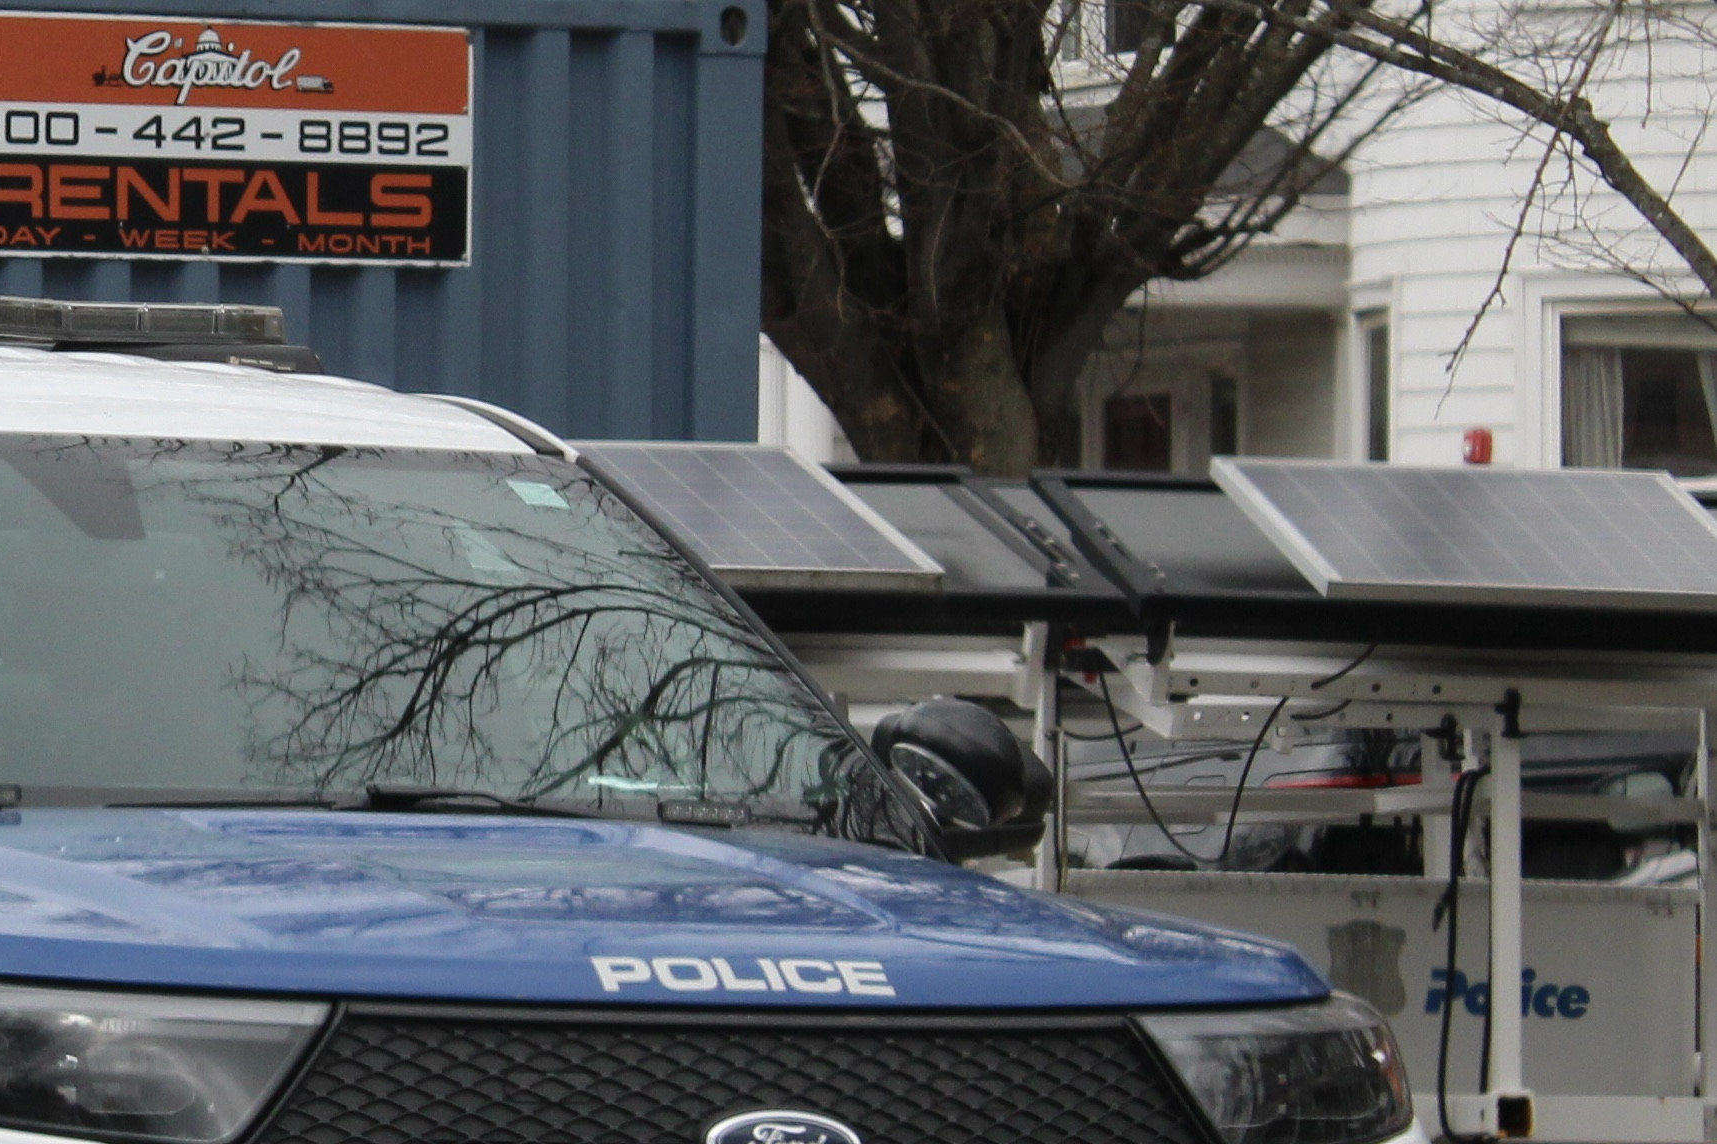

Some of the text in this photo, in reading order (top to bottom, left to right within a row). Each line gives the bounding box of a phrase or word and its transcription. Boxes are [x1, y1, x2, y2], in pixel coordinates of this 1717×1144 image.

[121, 30, 301, 106] Capitol
[119, 229, 236, 251] WEEK
[298, 232, 432, 256] MONTH
[590, 956, 897, 998] POLICE
[1424, 967, 1590, 1019] Poice
